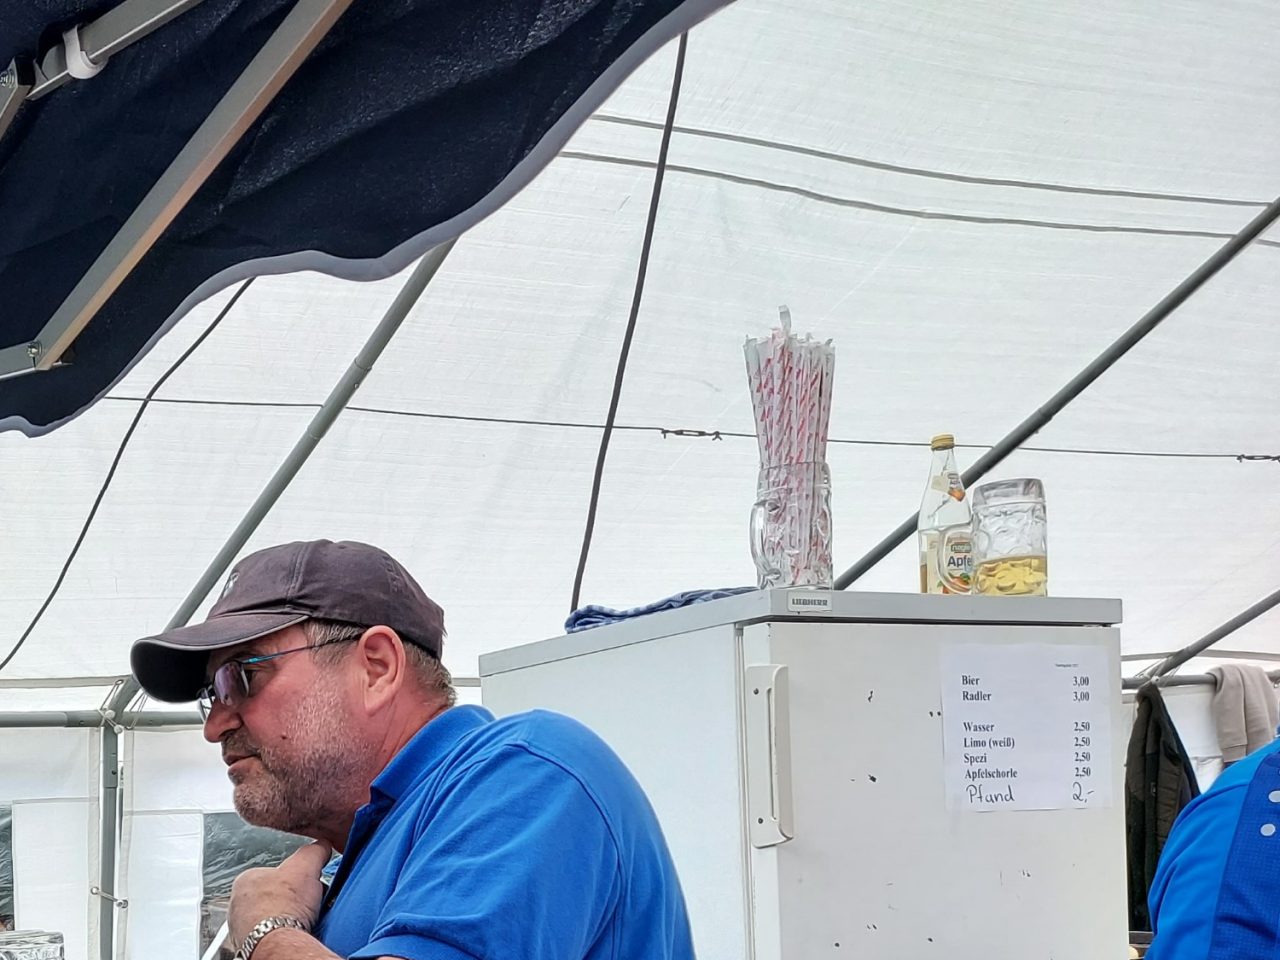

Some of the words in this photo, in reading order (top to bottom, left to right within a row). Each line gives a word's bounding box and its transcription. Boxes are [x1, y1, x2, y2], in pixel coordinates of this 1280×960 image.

[961, 675, 980, 686] Bier
[1072, 676, 1090, 688] 3,00
[962, 690, 992, 701] Radler
[1073, 691, 1090, 703] 3,00
[963, 722, 995, 732] Wasser
[1074, 722, 1091, 733] 2,50
[963, 737, 987, 748] Limo
[988, 737, 1016, 749] (weiß)
[1074, 736, 1091, 748] 2,50
[963, 752, 987, 766] Spezi
[1074, 751, 1091, 763] 2,50
[964, 767, 1018, 781] Apfelschorle
[1074, 766, 1091, 778] 2,50
[966, 784, 1016, 803] Pfand
